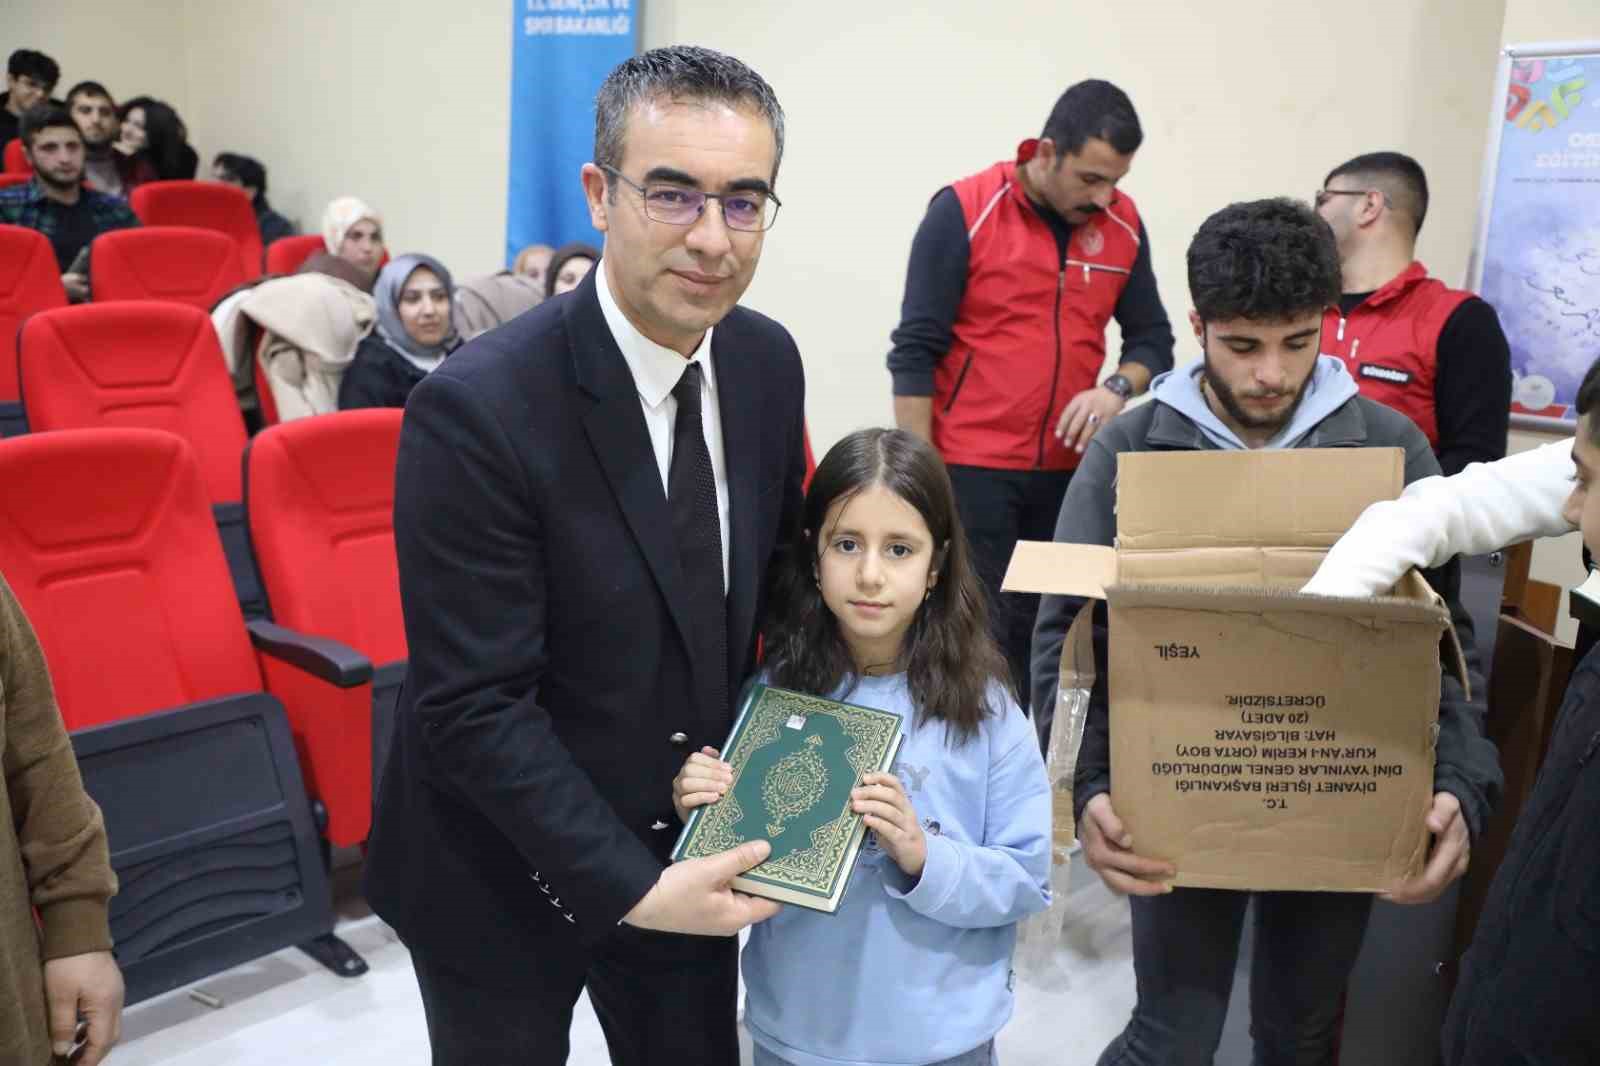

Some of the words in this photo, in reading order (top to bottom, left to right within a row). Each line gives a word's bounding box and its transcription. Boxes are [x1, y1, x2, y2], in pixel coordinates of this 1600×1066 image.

[1154, 643, 1200, 661] YEŞİL
[1225, 695, 1326, 709] ÜCRETSİZDİR.
[1241, 711, 1284, 724] ADET)
[1288, 711, 1309, 724] (20
[1215, 730, 1300, 743] BİLGİSAYAR
[1305, 731, 1335, 741] HAT:
[1176, 744, 1210, 757] BOY)
[1215, 745, 1257, 757] (ORTA
[1262, 748, 1307, 760] KERİM
[1152, 763, 1242, 776] MÜDÜRLÜĞÜ
[1246, 764, 1294, 775] GENEL
[1299, 765, 1369, 775] YAYINLAR
[1373, 765, 1402, 777] DİNİ
[1176, 780, 1261, 792] BAŞKANLIĞI
[1266, 780, 1311, 794] İŞLERİ
[1315, 782, 1376, 795] DİYANET
[1263, 799, 1287, 809] T.C.
